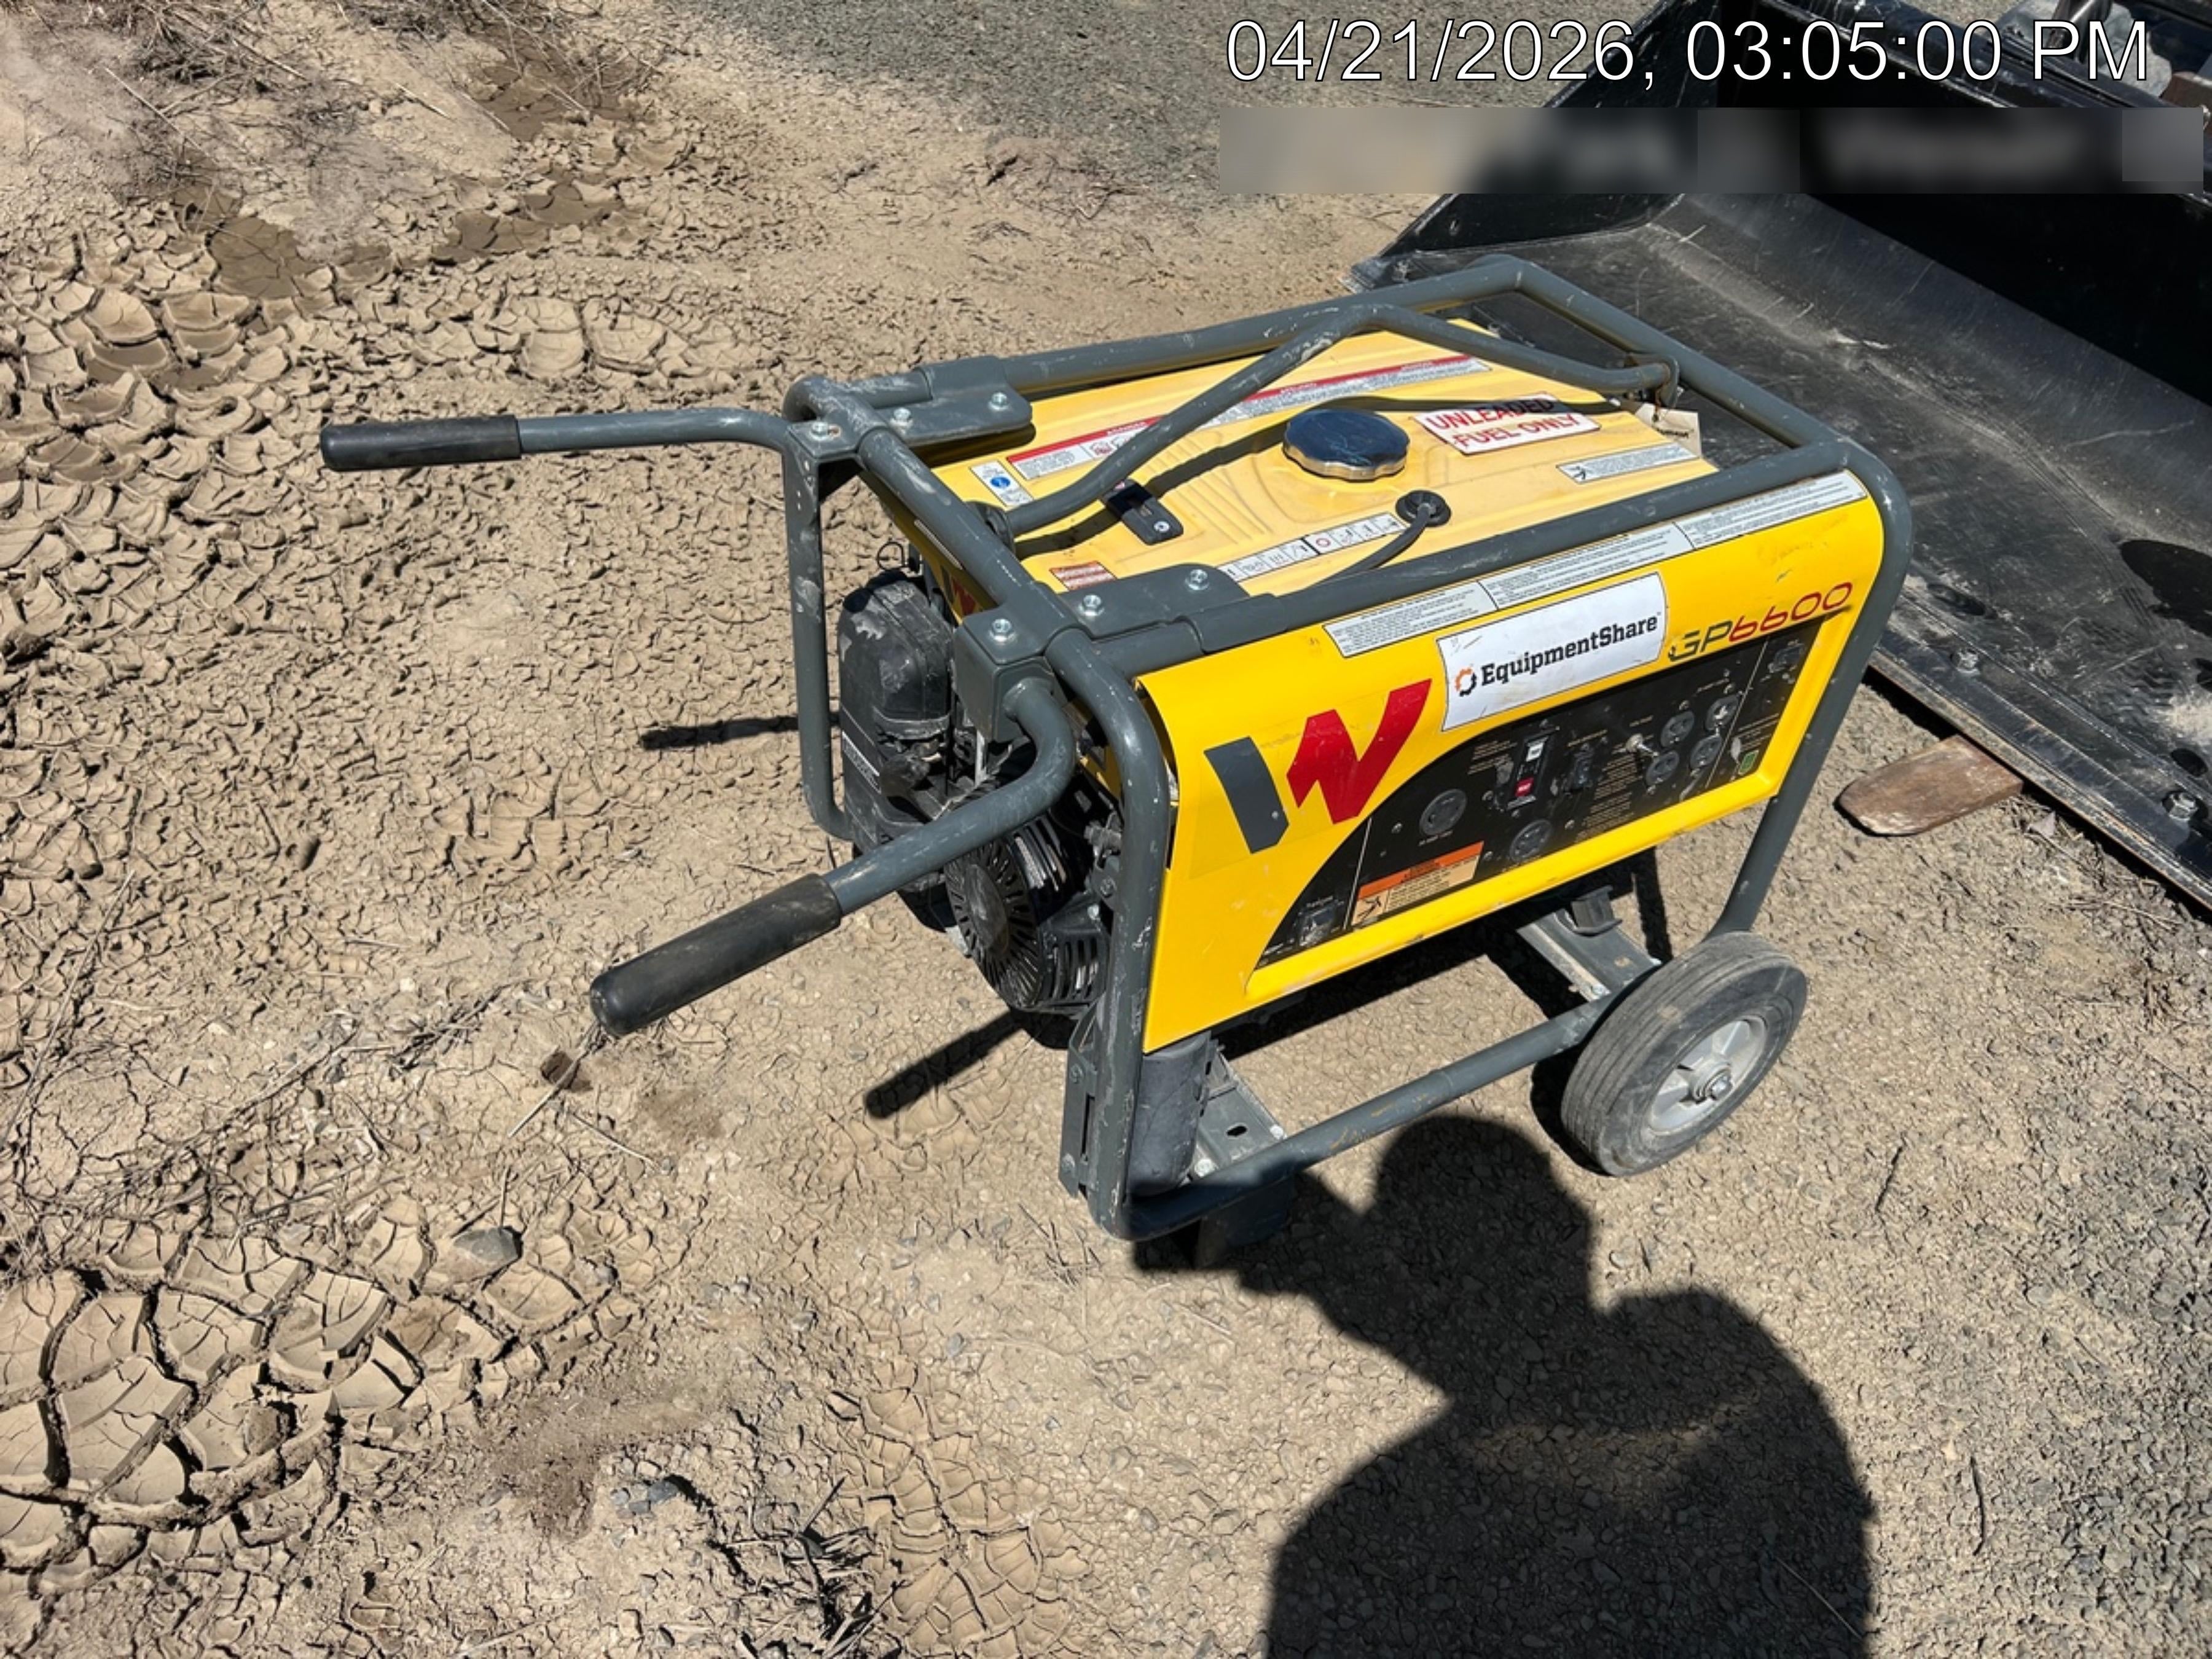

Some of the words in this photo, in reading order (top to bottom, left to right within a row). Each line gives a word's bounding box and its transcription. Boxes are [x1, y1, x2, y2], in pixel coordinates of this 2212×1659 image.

[1426, 398, 1555, 429] UNLEADED
[1452, 426, 1521, 447] FUEL
[1517, 413, 1581, 433] ONLY
[1668, 582, 1853, 662] GP6600
[1481, 615, 1658, 685] EquipmentShare
